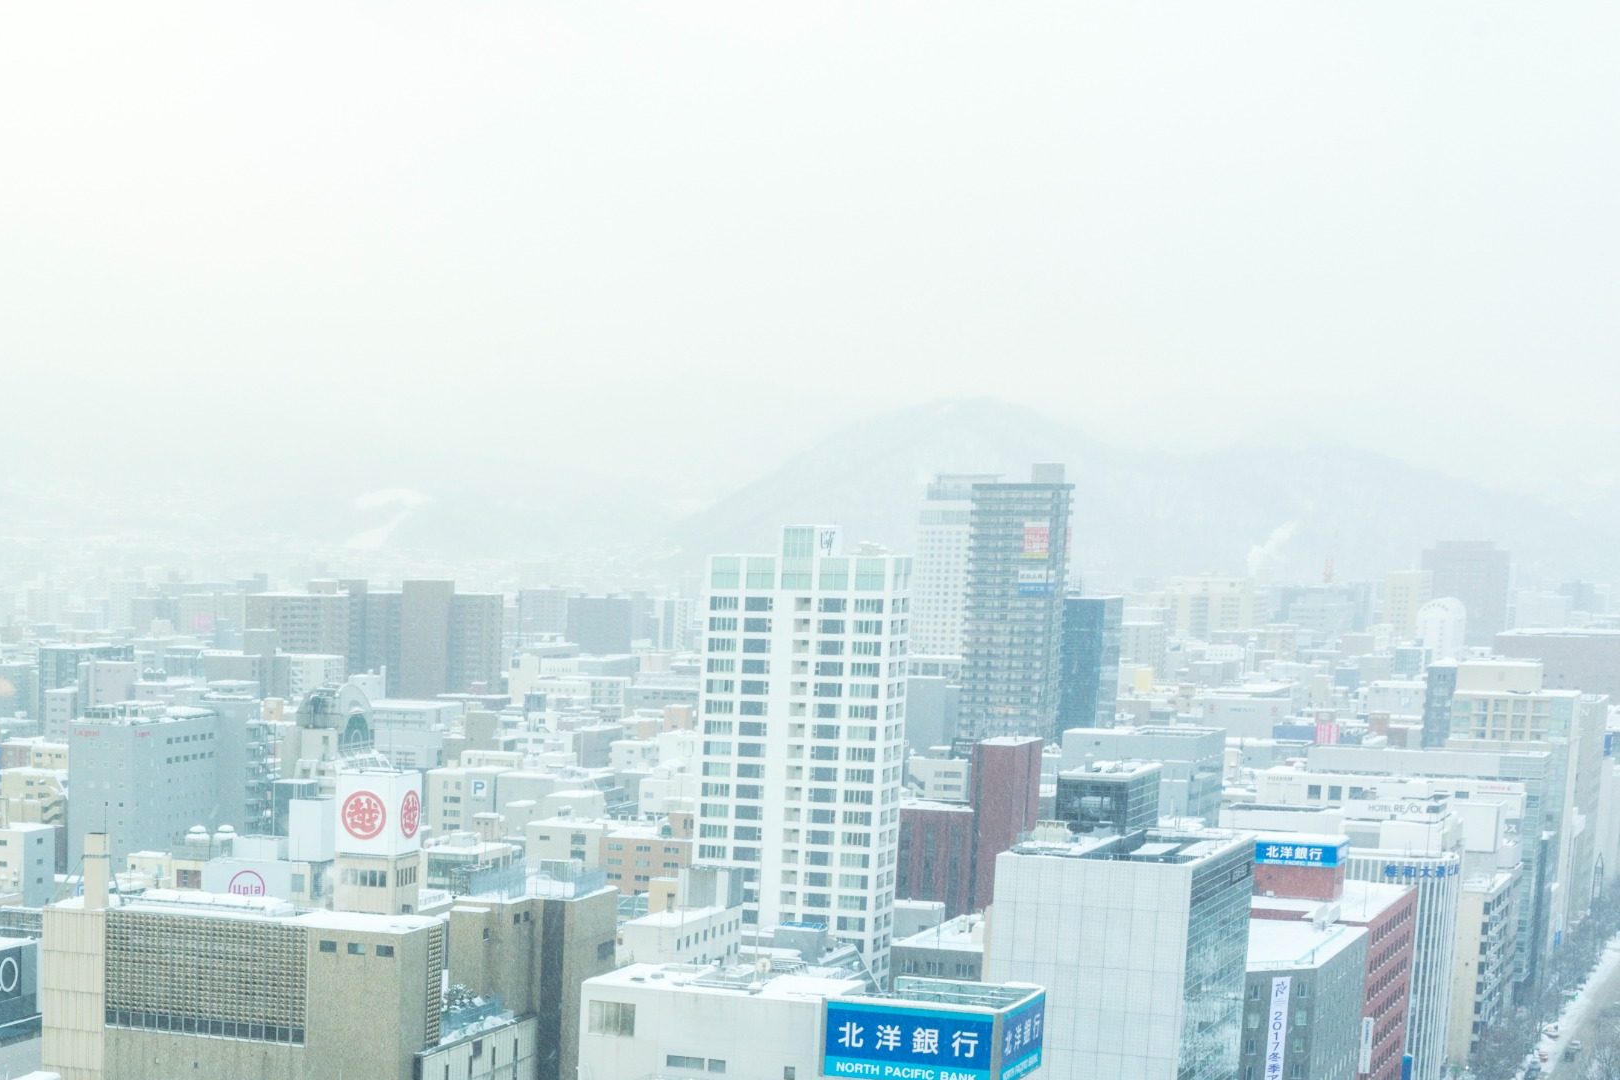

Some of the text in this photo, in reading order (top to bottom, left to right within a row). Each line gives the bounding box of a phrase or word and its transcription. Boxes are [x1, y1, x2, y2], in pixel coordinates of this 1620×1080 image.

[473, 781, 485, 794] P
[1265, 845, 1323, 861] 北洋銀行
[837, 1021, 980, 1059] 北洋銀行
[1004, 1013, 1042, 1056] 北洋銀行
[835, 1061, 880, 1075] NORTH
[884, 1067, 935, 1080] PACIFIC
